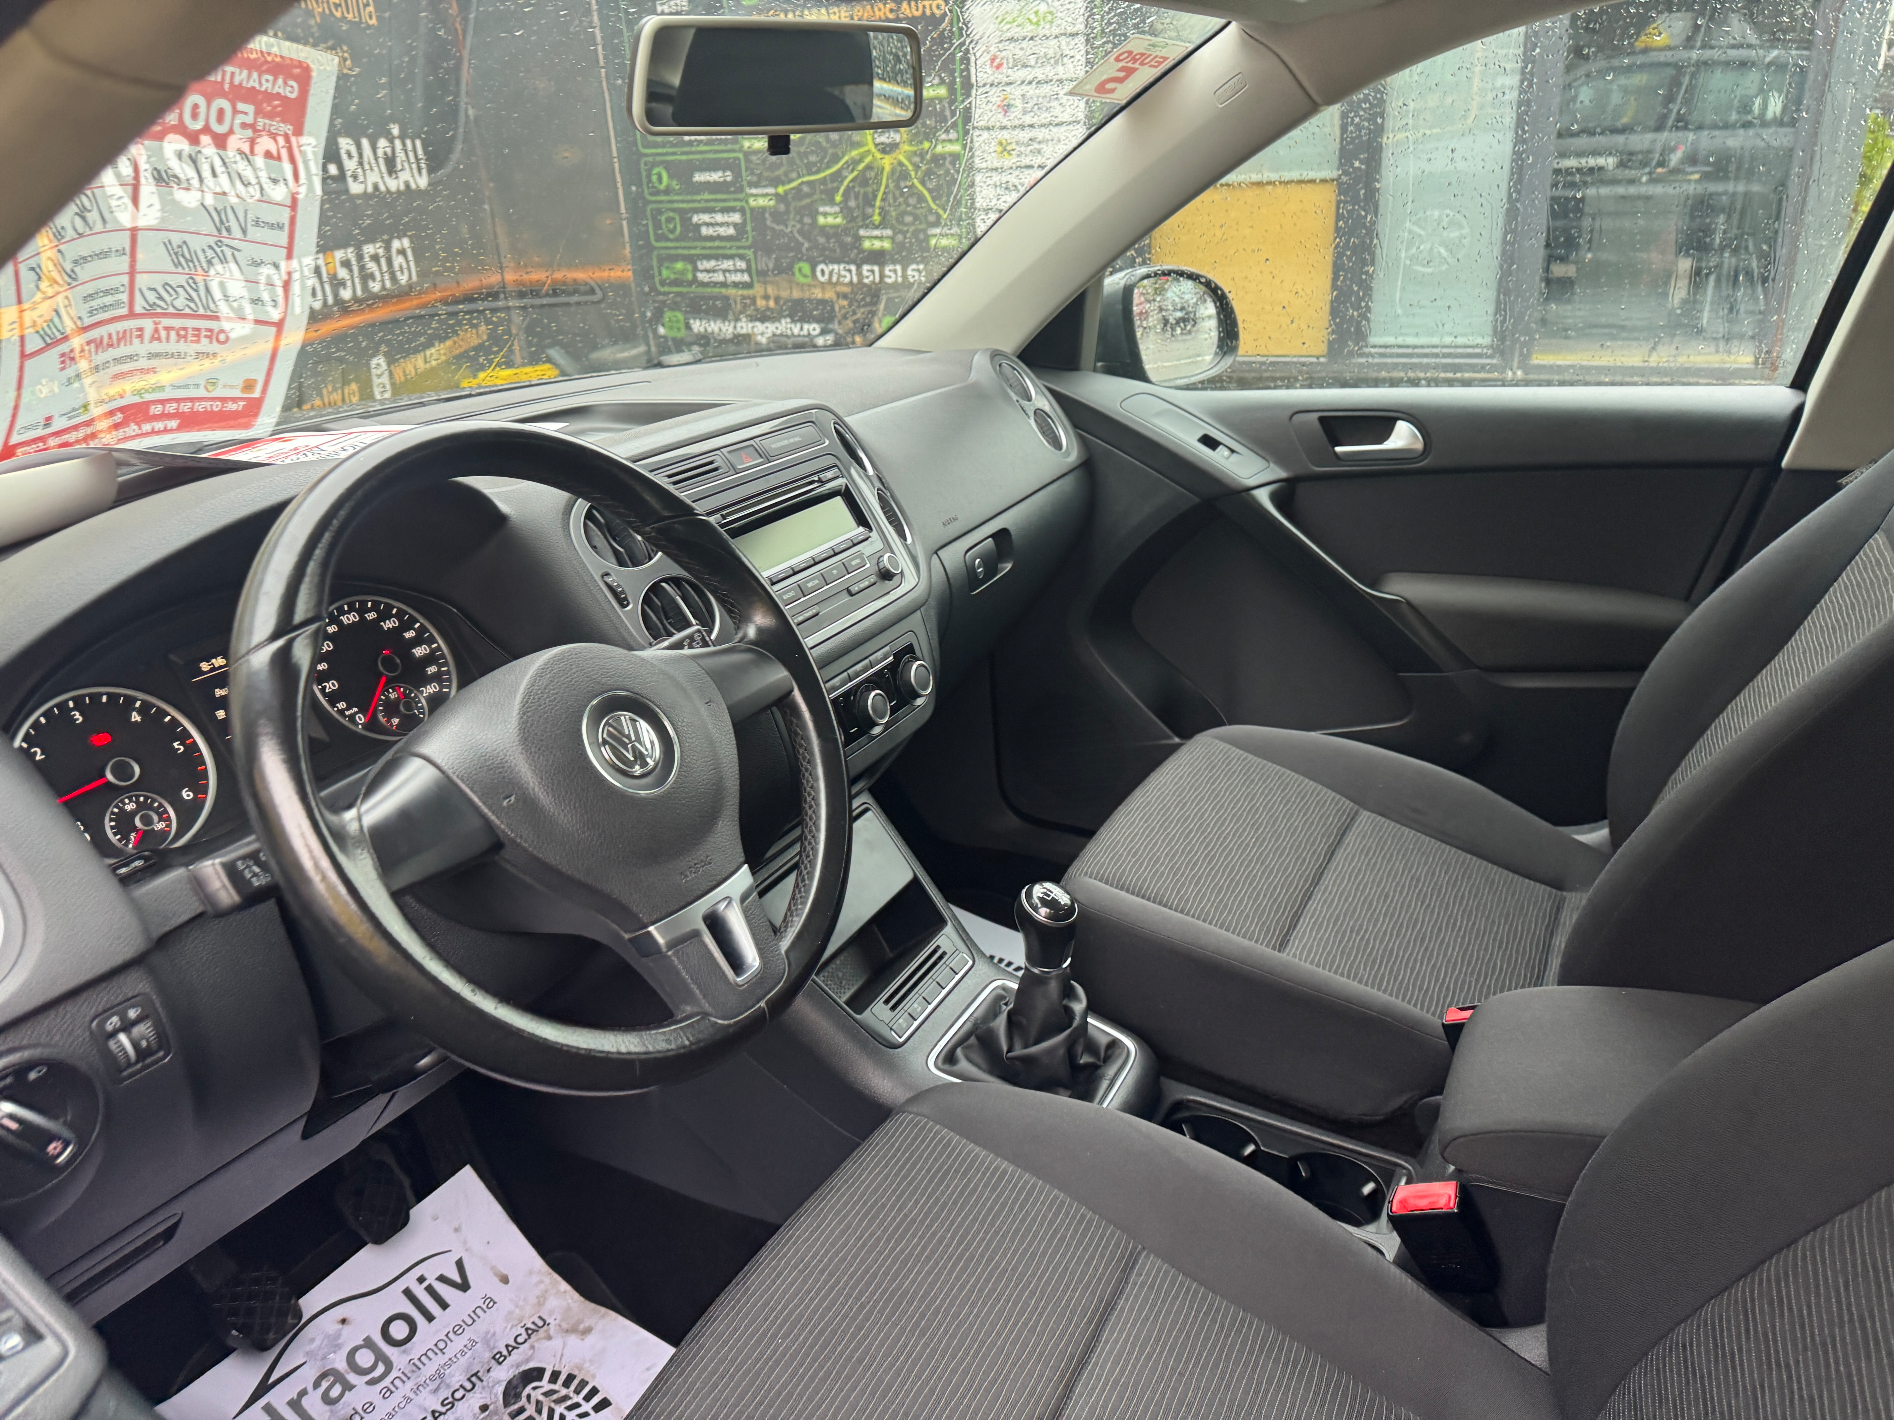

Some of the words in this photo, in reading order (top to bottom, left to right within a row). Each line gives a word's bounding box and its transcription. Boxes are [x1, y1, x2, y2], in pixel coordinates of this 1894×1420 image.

[853, 4, 897, 20] PARC
[900, 0, 946, 18] AUTO
[337, 123, 429, 194] BACĂU
[334, 247, 363, 300] 51
[363, 241, 390, 293] 51
[391, 237, 418, 285] 61
[816, 264, 857, 283] 0751
[862, 264, 880, 283] 51
[884, 264, 902, 283] 51
[690, 317, 822, 336] www.dragoliv.ro
[340, 612, 360, 625] 100
[364, 611, 378, 621] 120
[326, 624, 339, 634] 80
[380, 617, 399, 631] 140
[403, 630, 417, 639] 160
[412, 644, 430, 658] 180
[316, 662, 328, 671] 40
[322, 680, 339, 693] 20
[420, 682, 440, 697] 240
[336, 701, 347, 710] 10
[71, 711, 84, 724] 3
[130, 711, 142, 723] 4
[355, 713, 365, 724] 0
[30, 746, 46, 761] 2
[172, 741, 184, 754] 5
[181, 787, 194, 800] 6
[124, 802, 137, 811] 90
[153, 821, 166, 831] 130
[379, 1367, 410, 1400] ani
[408, 1293, 498, 1371] împreună
[410, 1336, 479, 1397] înregistrată
